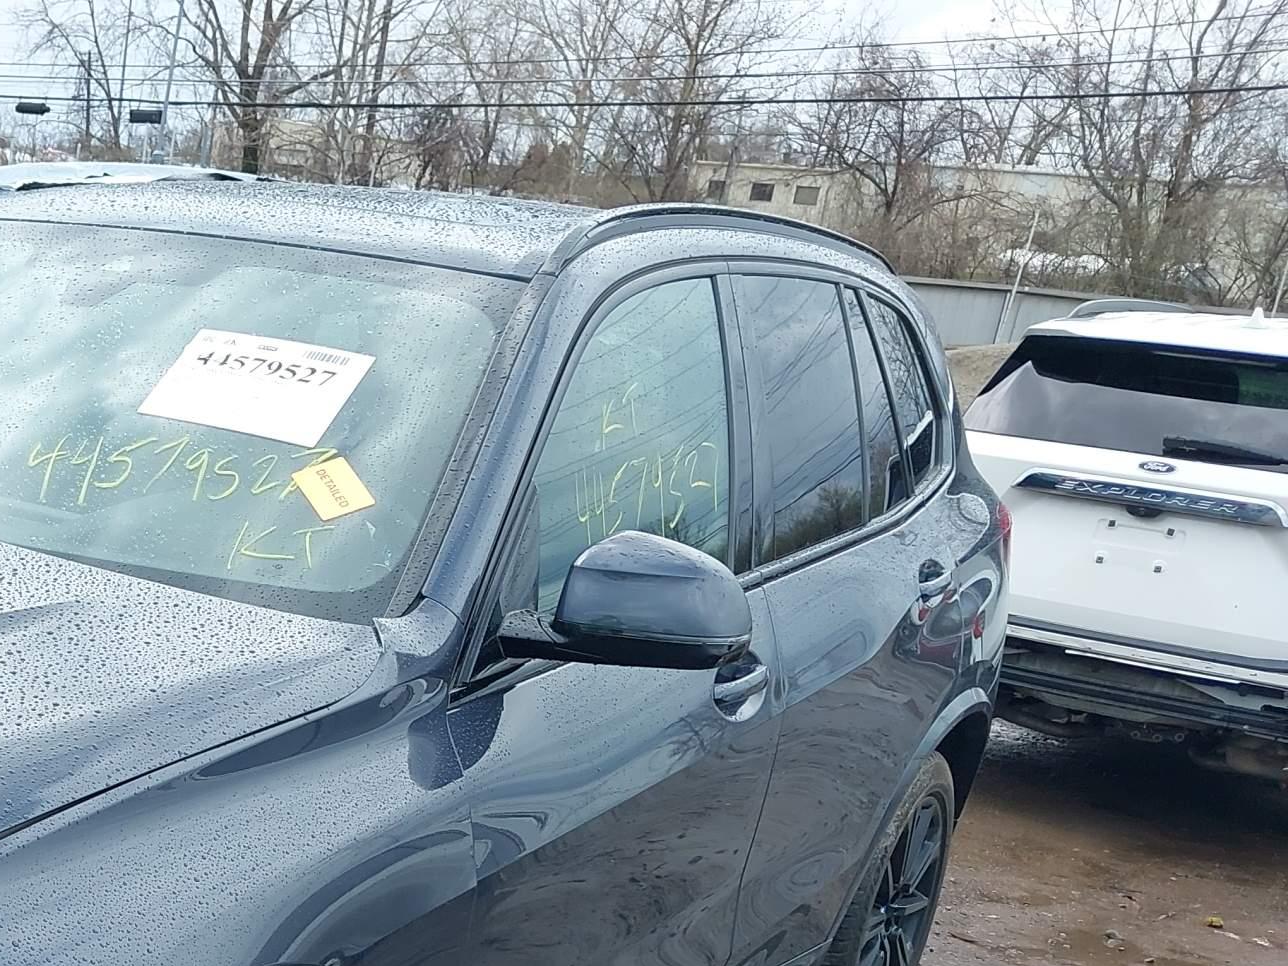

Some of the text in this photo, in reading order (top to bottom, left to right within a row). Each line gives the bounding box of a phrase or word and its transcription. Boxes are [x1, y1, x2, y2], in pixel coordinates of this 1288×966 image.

[196, 351, 338, 386] 44579527
[315, 468, 350, 509] DETAILED
[1054, 479, 1240, 515] EXPLORER
